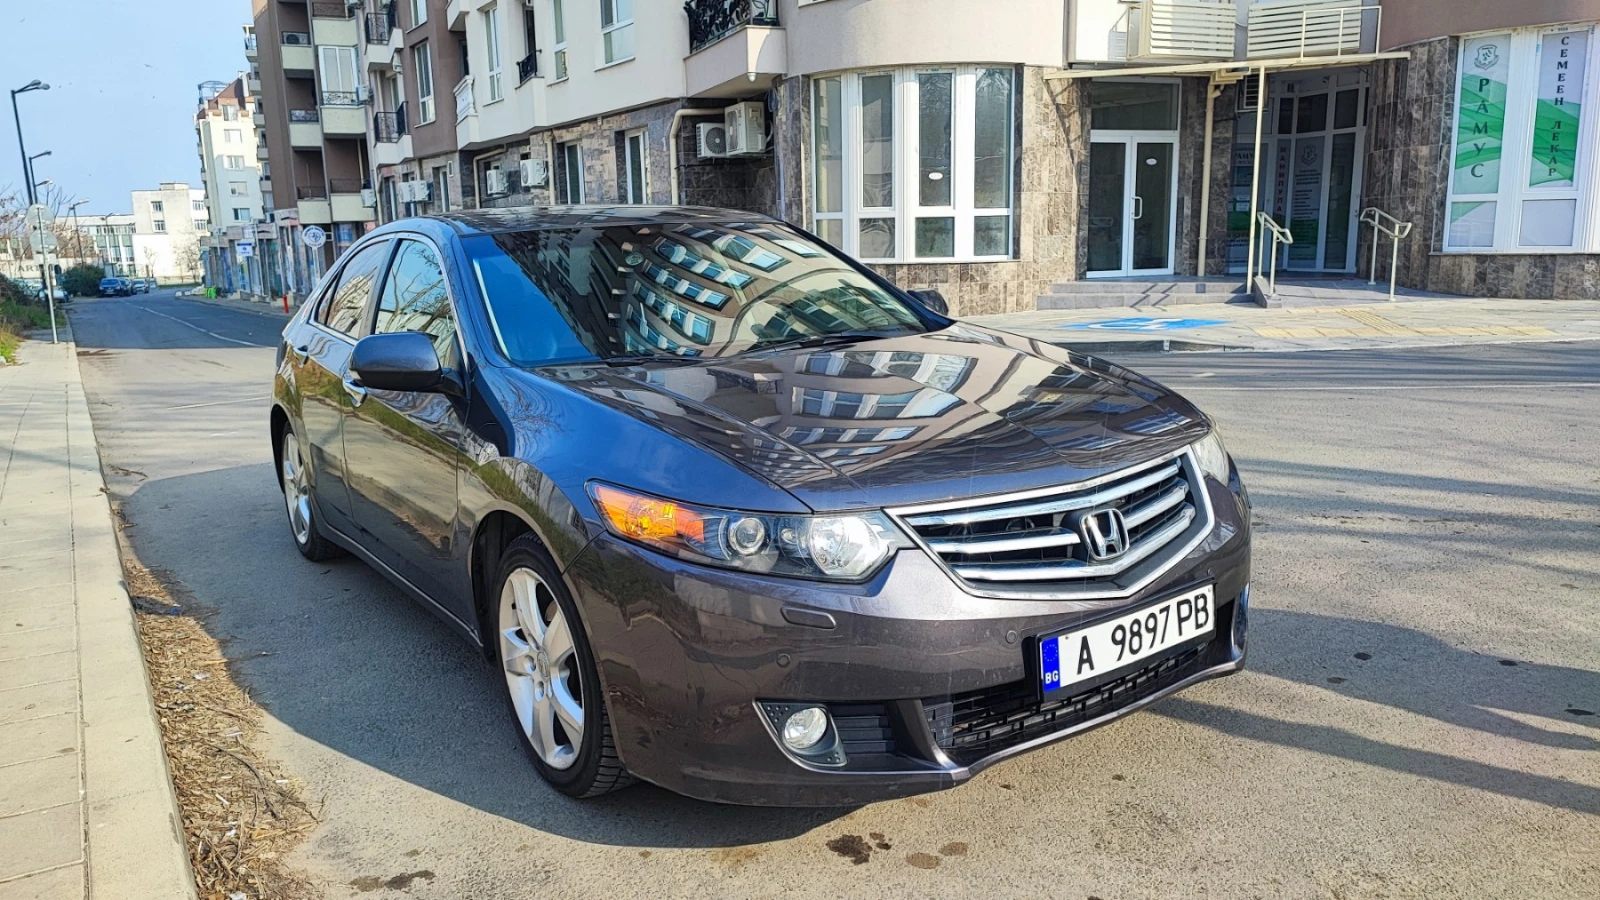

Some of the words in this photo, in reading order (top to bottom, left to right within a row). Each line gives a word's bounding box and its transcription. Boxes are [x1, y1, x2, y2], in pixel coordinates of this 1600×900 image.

[1554, 36, 1569, 106] СЕМЕЕН
[1471, 78, 1490, 178] РАМУС
[1549, 120, 1562, 176] ЛЕКАР
[1077, 635, 1095, 675] A
[1111, 604, 1171, 662] 9897
[1176, 593, 1210, 637] PB
[1044, 669, 1059, 684] BG
